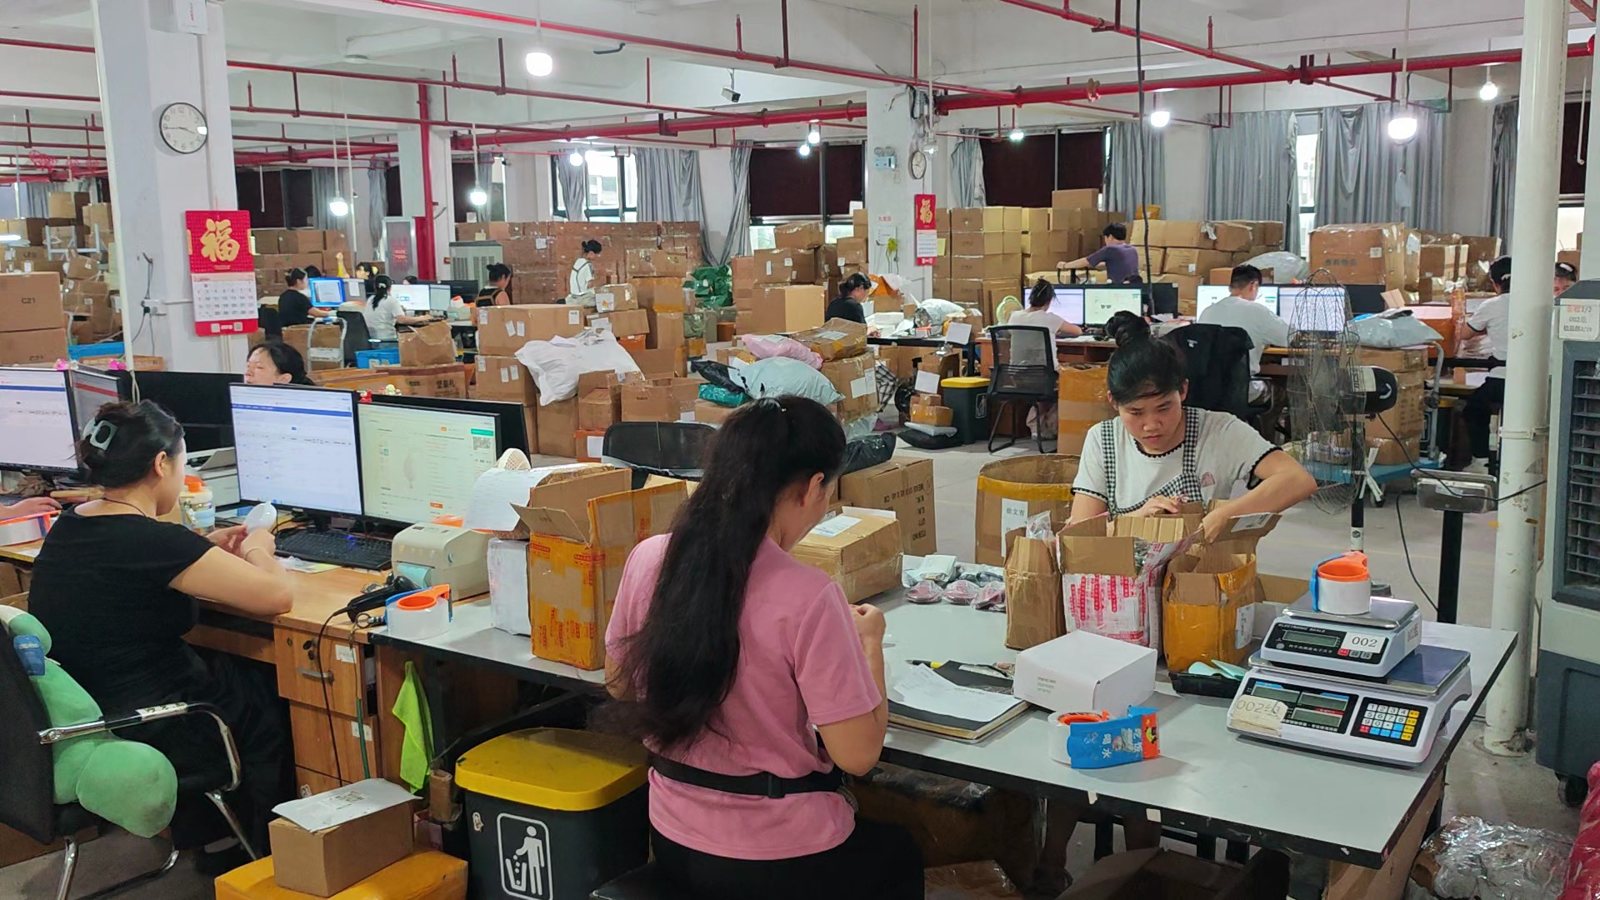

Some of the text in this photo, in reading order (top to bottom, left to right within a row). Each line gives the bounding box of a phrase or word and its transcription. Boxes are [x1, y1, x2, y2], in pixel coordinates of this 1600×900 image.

[920, 198, 933, 224] 福
[200, 218, 240, 262] 福
[1351, 636, 1378, 648] 002
